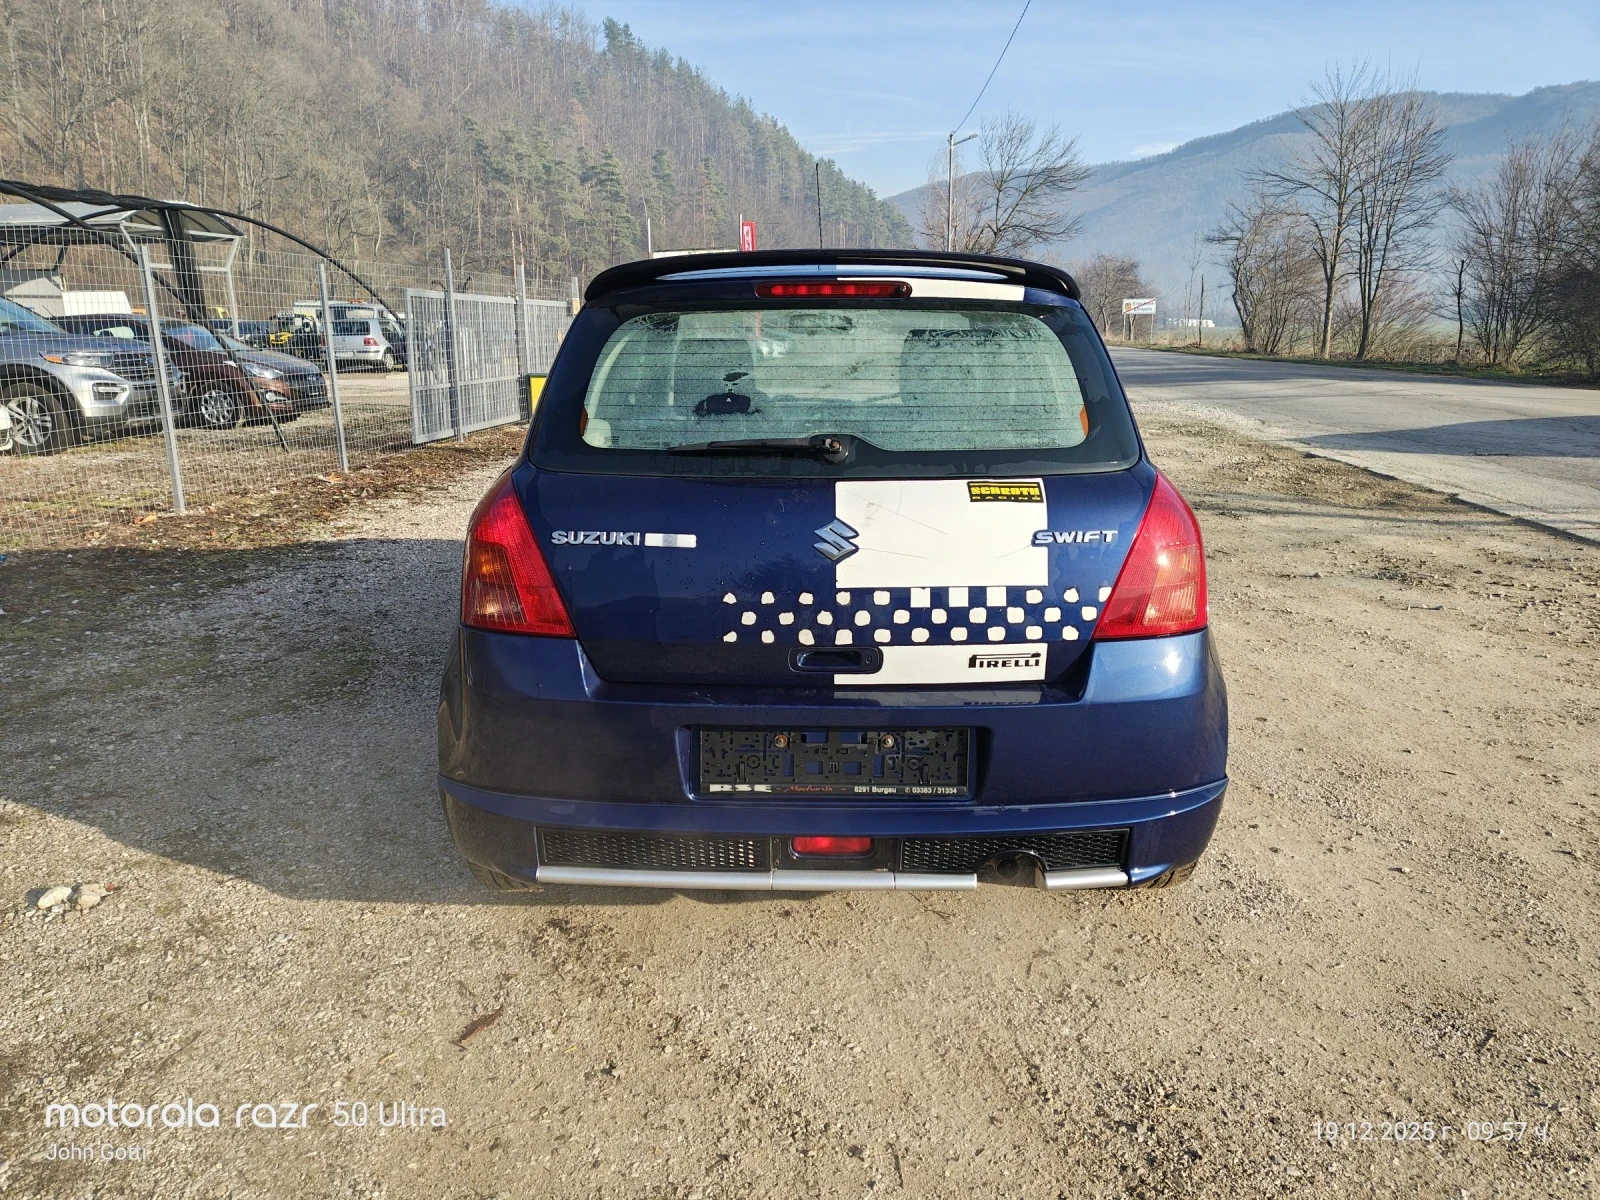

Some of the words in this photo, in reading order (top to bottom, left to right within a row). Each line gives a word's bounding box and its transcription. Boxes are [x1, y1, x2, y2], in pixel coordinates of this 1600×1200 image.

[970, 486, 1040, 496] SCHROTH
[550, 530, 641, 546] SUZUKI
[1034, 530, 1119, 544] SWIFT
[968, 652, 1042, 669] PIRELLI
[854, 785, 870, 793] 8291
[871, 785, 897, 795] Burgau
[937, 787, 958, 795] 31334
